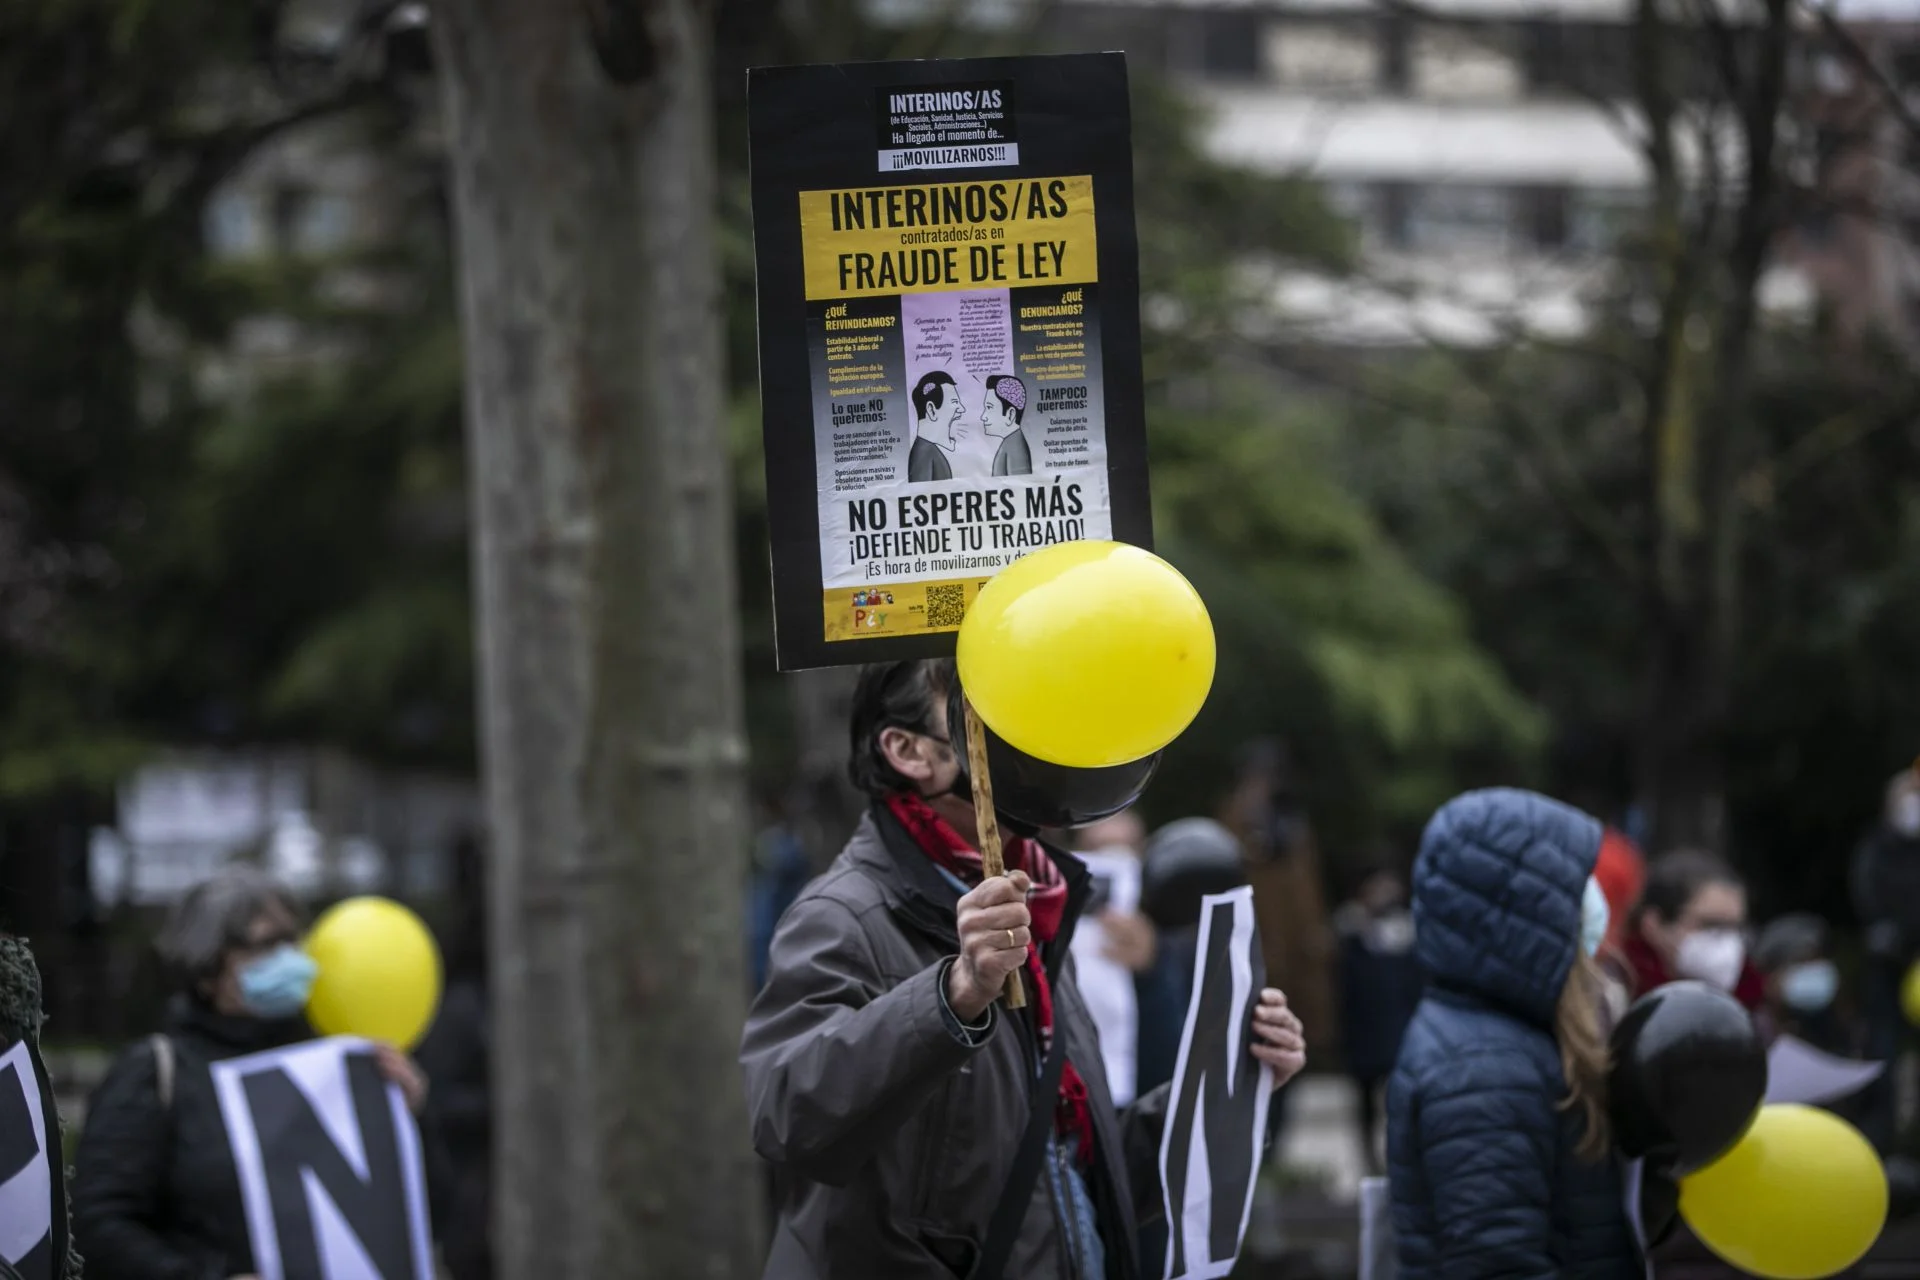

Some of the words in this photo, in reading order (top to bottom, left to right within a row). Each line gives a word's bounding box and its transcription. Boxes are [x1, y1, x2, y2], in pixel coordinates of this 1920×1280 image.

[890, 89, 1002, 114] INTERINOS/AS
[978, 111, 1003, 120] Servicios
[892, 132, 904, 144] Ha
[906, 131, 936, 144] llegado
[938, 130, 946, 141] el
[948, 129, 985, 140] momento
[830, 179, 1069, 232] INTERINOS/AS
[900, 225, 987, 245] contratados/as
[990, 226, 1004, 240] en
[838, 247, 959, 290] FRAUDE
[970, 244, 1007, 282] DE
[1017, 240, 1067, 279] LEY
[1062, 288, 1083, 304] ¿QUÉ
[825, 303, 848, 319] ¿QUÉ
[1021, 305, 1084, 318] DENUNCIAMOS?
[825, 316, 896, 330] REIVINDICAMOS?
[1040, 386, 1087, 401] TAMPOCO
[832, 402, 844, 415] Lo
[847, 403, 866, 417] que
[869, 399, 884, 412] NO
[1037, 400, 1088, 414] queremos:
[832, 412, 887, 428] queremos:
[849, 498, 887, 532] NO
[899, 489, 1016, 529] ESPERES
[1026, 475, 1083, 519] MÁS
[850, 528, 951, 565] ¡DEFIENDE
[958, 526, 983, 551] TU
[989, 518, 1085, 549] TRABAJO!
[865, 561, 881, 580] ¡Es
[885, 557, 911, 576] hora
[915, 556, 927, 572] de
[931, 553, 1001, 572] movilizarnos
